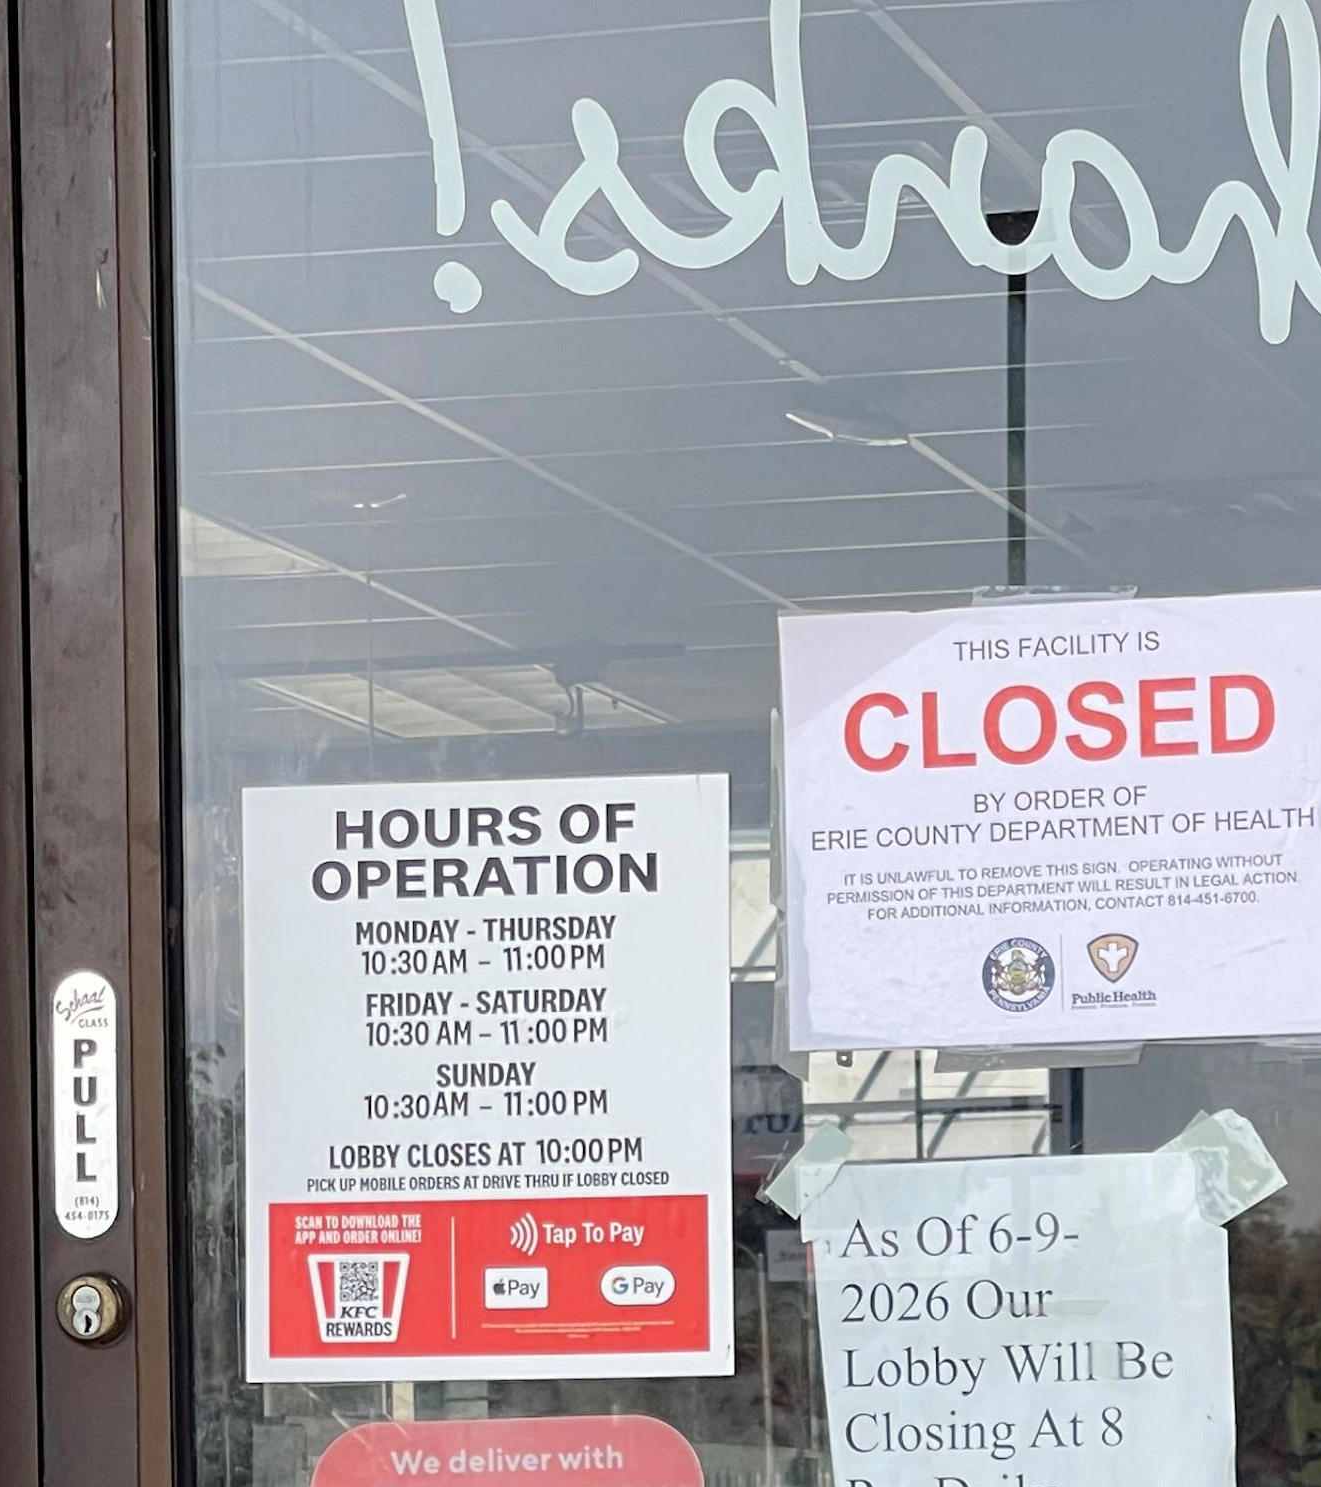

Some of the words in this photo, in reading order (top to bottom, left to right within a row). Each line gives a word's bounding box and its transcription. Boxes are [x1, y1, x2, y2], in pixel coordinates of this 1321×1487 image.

[953, 639, 1009, 661] THIS
[1019, 632, 1129, 657] FACILITY
[1138, 631, 1159, 651] IS
[845, 675, 1274, 771] CLOSED
[974, 793, 1005, 813] BY
[1015, 788, 1105, 810] ORDER
[1114, 785, 1146, 806] OF
[336, 806, 541, 850] HOURS
[560, 803, 635, 844] OF
[812, 829, 868, 851] ERIE
[877, 824, 981, 847] COUNTY
[990, 815, 1164, 842] DEPARTMENT
[1172, 813, 1205, 833] OF
[1215, 807, 1314, 831] HEALTH
[312, 853, 657, 900] OPERATION
[845, 874, 856, 886] IT
[861, 873, 873, 885] IS
[877, 870, 954, 884] UNLAWFUL
[958, 868, 977, 880] TO
[982, 865, 1042, 879] REMOVE
[1046, 863, 1078, 876] THIS
[1128, 857, 1212, 872] OPERATING
[1216, 854, 1283, 868] WITHOUT
[828, 889, 914, 904] PERMISSION
[918, 888, 937, 900] OF
[941, 887, 973, 898] THIS
[977, 881, 1074, 897] DEPARTMENT
[1078, 880, 1111, 892] WILL
[1116, 877, 1171, 890] RESULT
[1175, 876, 1189, 888] IN
[1193, 874, 1239, 887] LEGAL
[868, 908, 897, 920] FOR
[901, 904, 984, 918] ADDITIONAL
[989, 899, 1091, 914] INFORMATION,
[1095, 895, 1164, 910] CONTACT
[356, 920, 459, 945] MONDAY
[483, 915, 616, 941] THURSDAY
[362, 950, 427, 975] 10:30
[433, 949, 467, 974] AM
[503, 945, 565, 971] 11:00
[571, 944, 604, 969] PM
[367, 992, 452, 1017] FRIDAY
[477, 988, 606, 1014] SATURDAY
[1072, 992, 1112, 1003] Public
[1114, 990, 1156, 1001] Health
[366, 1021, 429, 1046] 10:30
[436, 1021, 471, 1045] AM
[574, 1018, 607, 1042] PM
[437, 1062, 536, 1088] SUNDAY
[73, 1039, 97, 1182] PULL
[364, 1095, 429, 1119] 10:30
[433, 1092, 468, 1116] AM
[504, 1091, 566, 1116] 11:00
[574, 1090, 607, 1115] PM
[330, 1145, 400, 1169] LOBBY
[408, 1143, 491, 1168] CLOSES
[498, 1142, 525, 1166] AT
[536, 1139, 603, 1164] 10:00
[608, 1137, 642, 1163] PM
[307, 1179, 335, 1192] PICK
[340, 1178, 356, 1191] UP
[360, 1177, 405, 1191] MOBILE
[409, 1176, 460, 1190] ORDERS
[464, 1176, 479, 1189] AT
[483, 1175, 520, 1189] DRIVE
[525, 1174, 559, 1188] THRU
[563, 1174, 573, 1187] IF
[577, 1173, 617, 1187] LOBBY
[621, 1171, 669, 1185] CLOSED
[295, 1216, 322, 1229] SCAN
[326, 1216, 338, 1228] TO
[342, 1215, 398, 1228] DOWNLOAD
[402, 1214, 420, 1228] THE
[295, 1231, 315, 1244] APP
[319, 1231, 340, 1244] AND
[343, 1230, 378, 1243] ORDER
[381, 1229, 421, 1243] ONLINE!
[542, 1222, 577, 1247] Tap
[582, 1222, 604, 1243] To
[609, 1222, 644, 1246] Pay
[840, 1219, 899, 1257] As
[917, 1214, 978, 1256] Of
[990, 1212, 1078, 1253] 6-9-
[508, 1280, 540, 1299] Pay
[612, 1277, 629, 1294] G
[634, 1277, 664, 1298] Pay
[842, 1281, 948, 1322] 2026
[967, 1280, 1052, 1319] Our
[340, 1306, 378, 1318] KFC
[326, 1322, 391, 1336] REWARDS
[845, 1346, 985, 1396] Lobby
[1002, 1342, 1095, 1382] Will
[1116, 1342, 1173, 1379] Be
[846, 1410, 1015, 1460] Closing
[1030, 1409, 1083, 1448] At
[1102, 1407, 1122, 1446] 8
[391, 1450, 440, 1475] We
[449, 1448, 551, 1473] deliver
[558, 1444, 622, 1469] with
